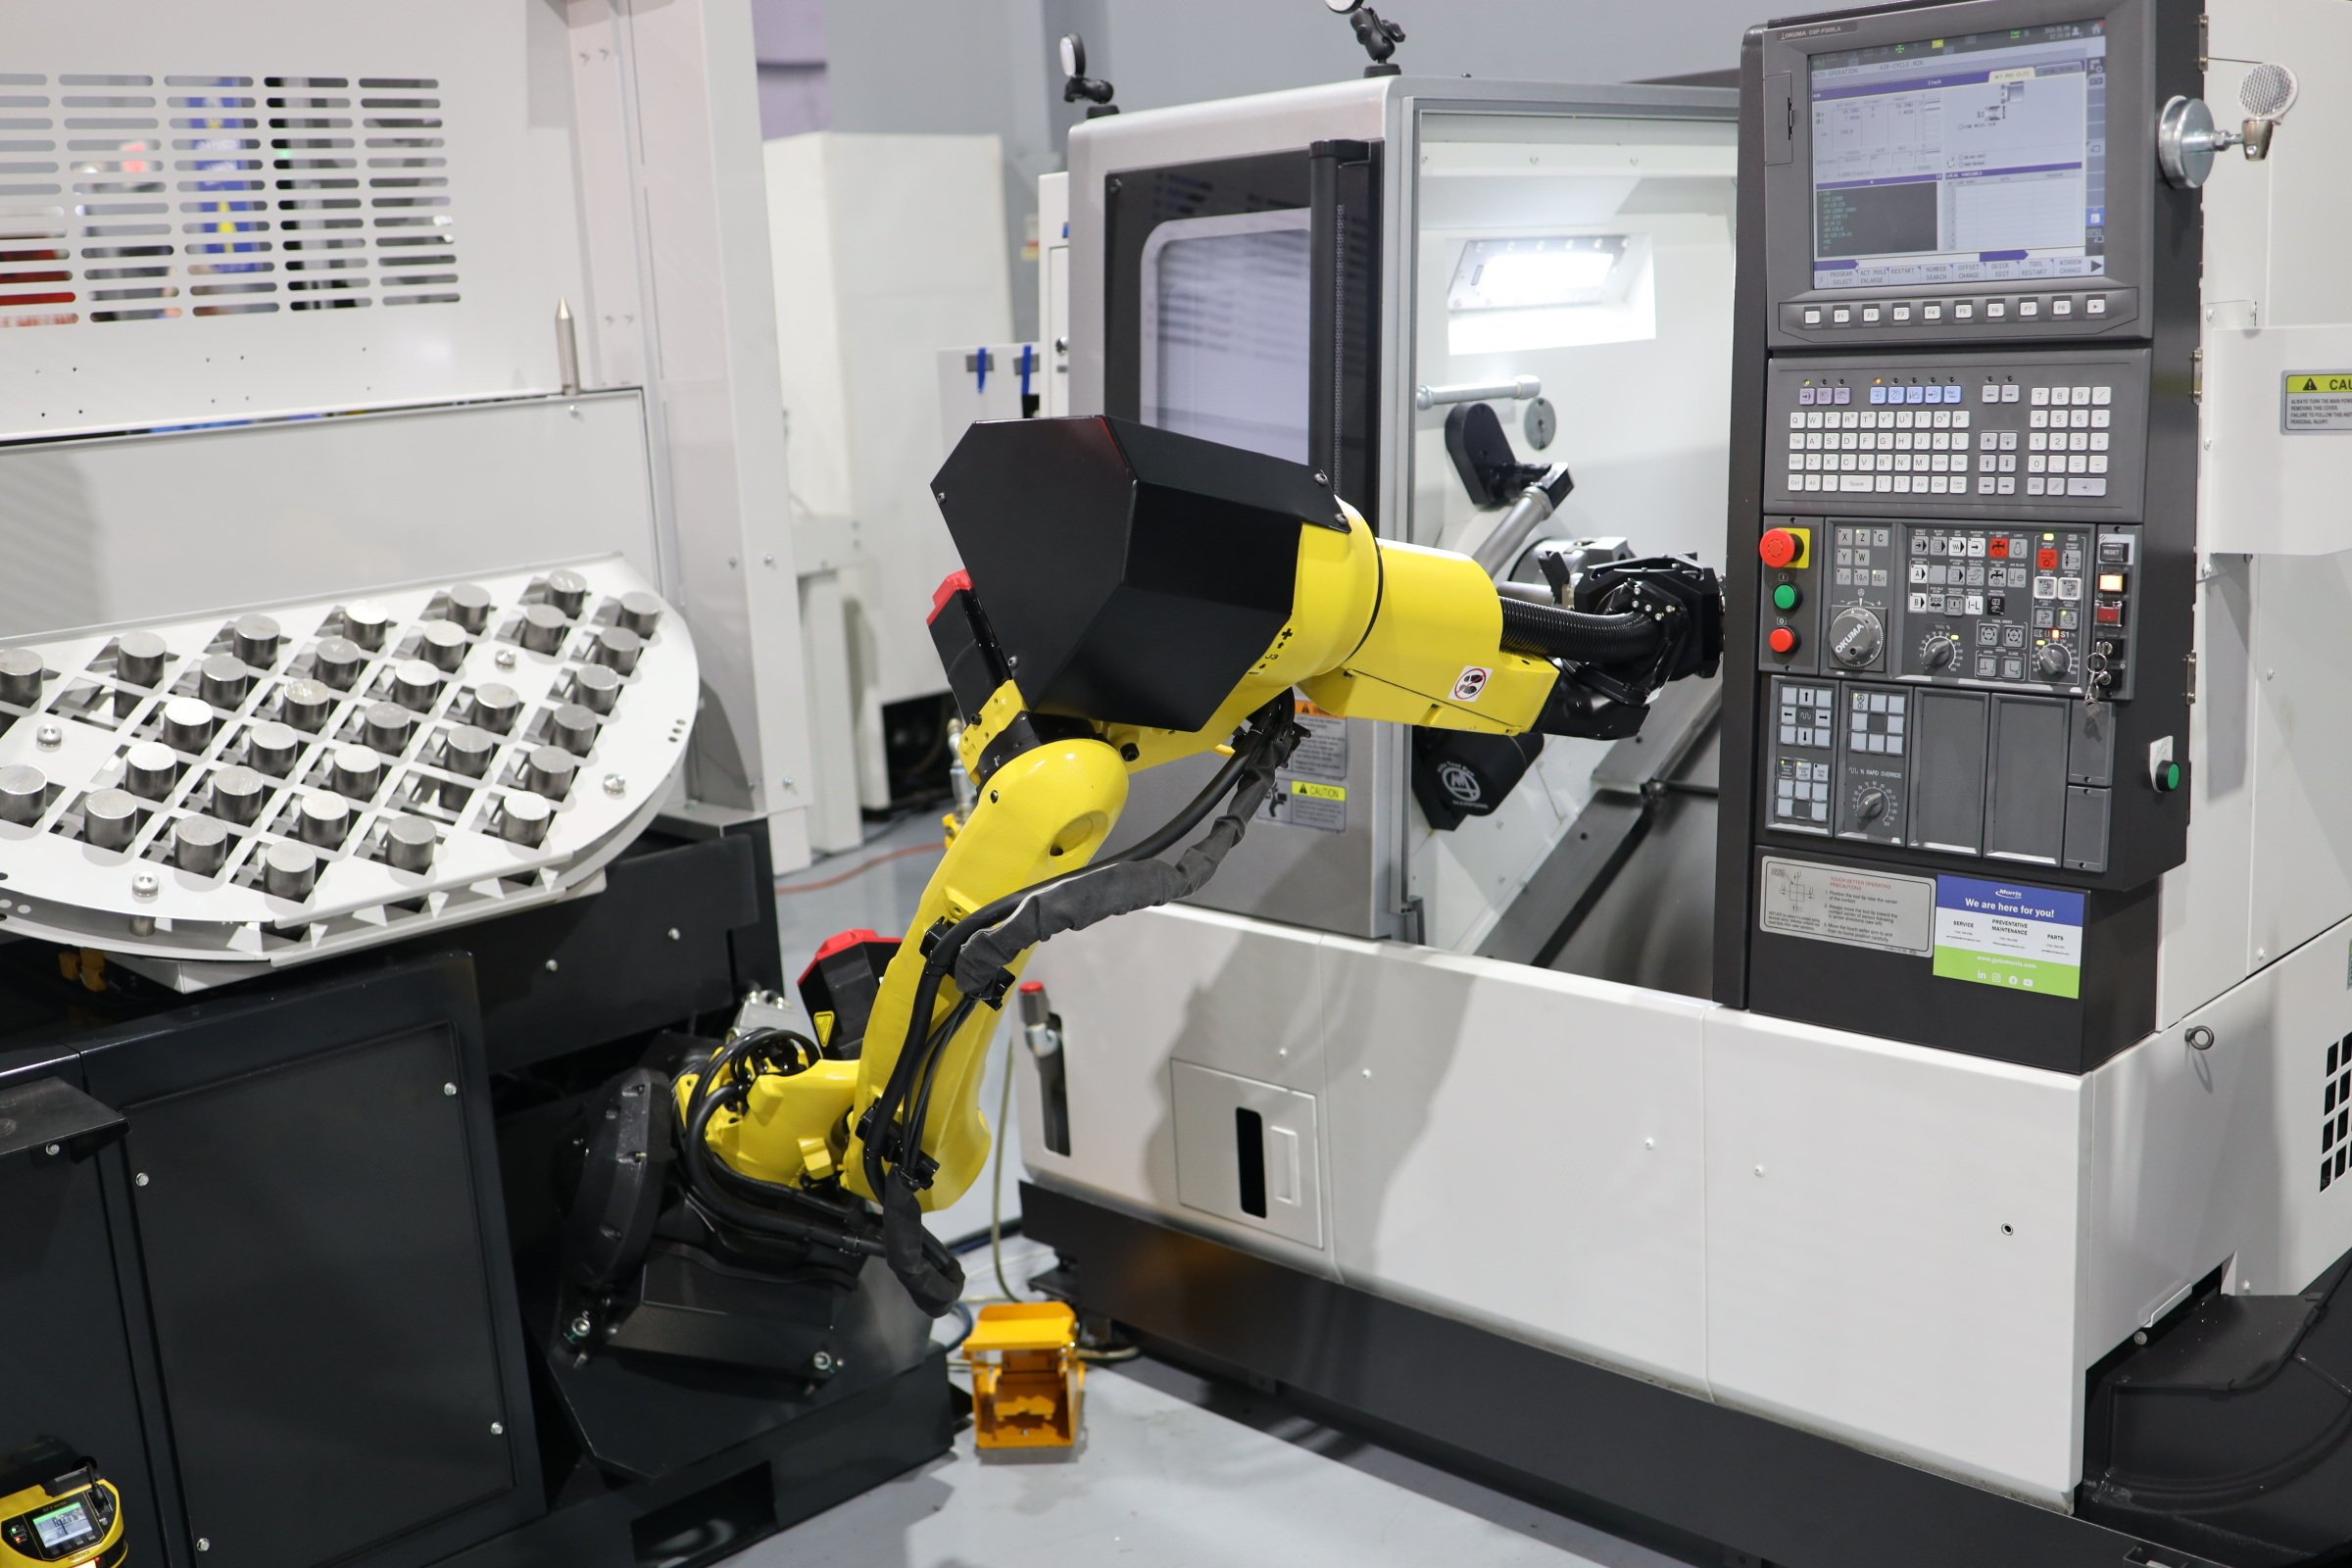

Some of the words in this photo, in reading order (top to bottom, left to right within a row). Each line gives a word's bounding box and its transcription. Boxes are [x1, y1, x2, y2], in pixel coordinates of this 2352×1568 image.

[1860, 533, 1865, 542] Z
[1878, 533, 1884, 543] C
[1841, 553, 1847, 562] Y
[1858, 553, 1866, 562] W
[1835, 622, 1865, 654] OKUMA
[1309, 785, 1340, 799] CAUTION
[1999, 888, 2023, 897] Morris
[1965, 897, 1980, 907] We
[1981, 901, 1996, 910] are
[1997, 902, 2019, 913] here
[2020, 905, 2034, 915] for
[2034, 908, 2055, 919] you!
[1991, 918, 2029, 929] PREVENTATIVE
[1991, 925, 2029, 936] MAINTENANCE
[2046, 933, 2064, 942] PARTS
